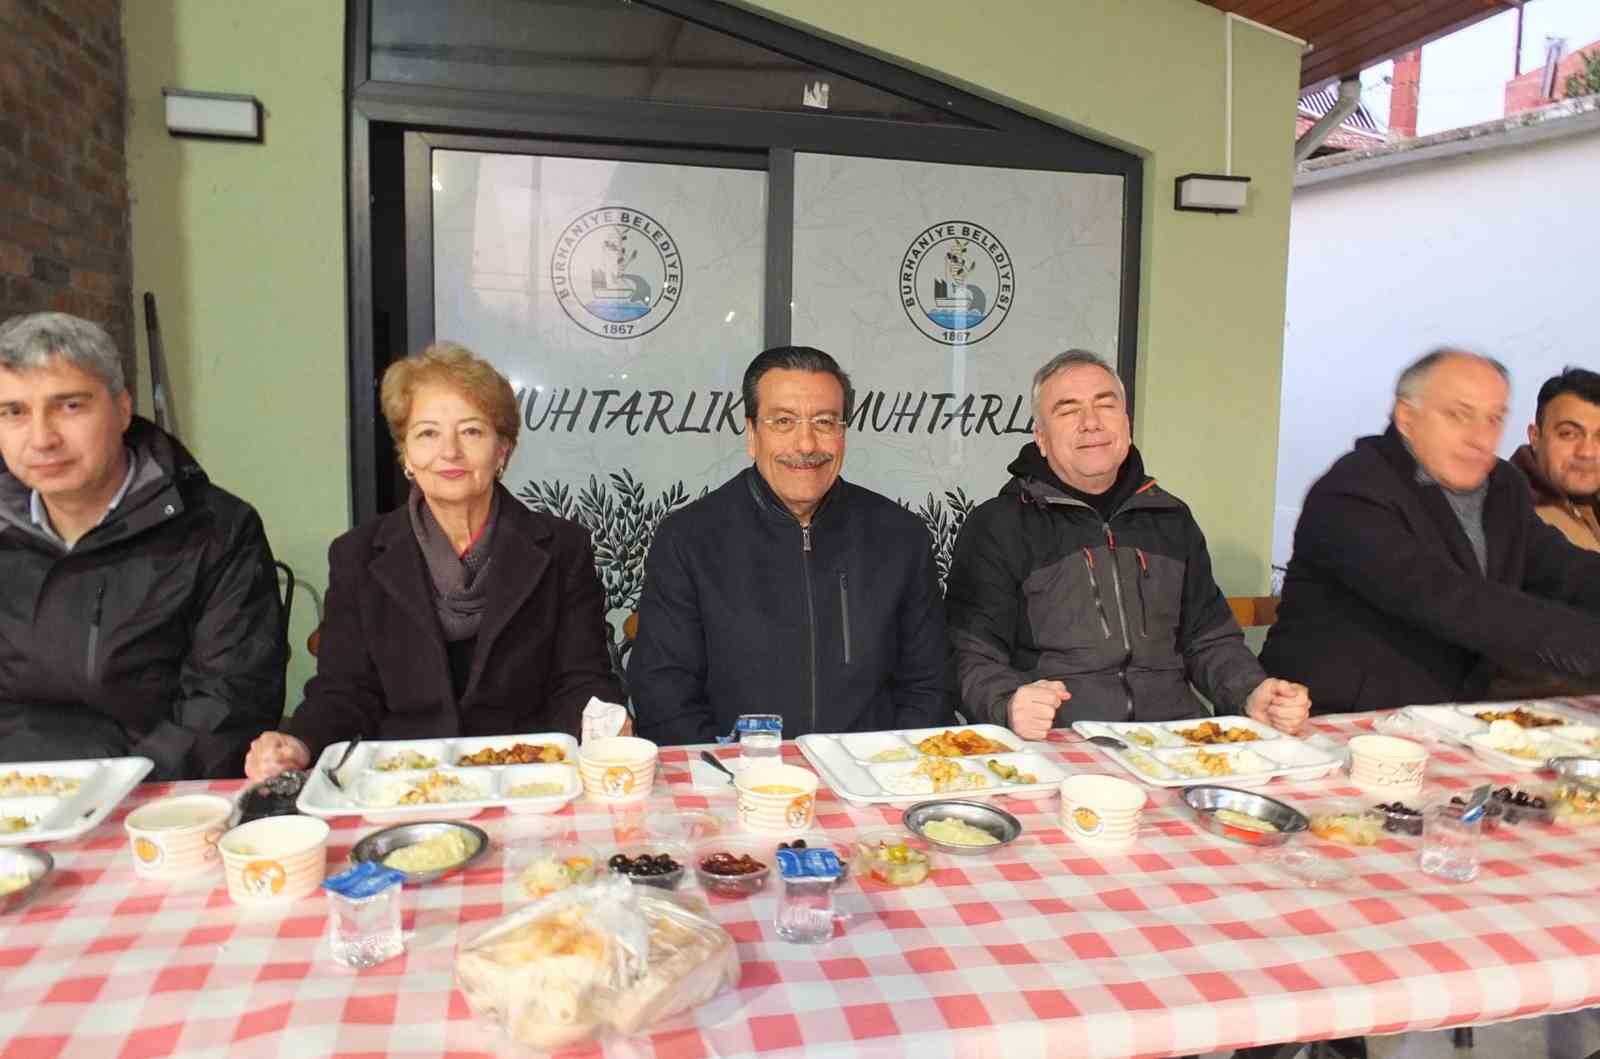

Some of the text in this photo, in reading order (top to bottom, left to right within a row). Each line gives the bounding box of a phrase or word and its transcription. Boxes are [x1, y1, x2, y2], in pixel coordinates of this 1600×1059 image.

[554, 211, 679, 302] BURHANİYE BELEDİYESİ
[903, 225, 1012, 312] BURHANİYE BELEDİYESİ
[602, 324, 634, 336] 1867
[942, 331, 971, 342] 1867
[516, 387, 746, 436] UHTARLIK
